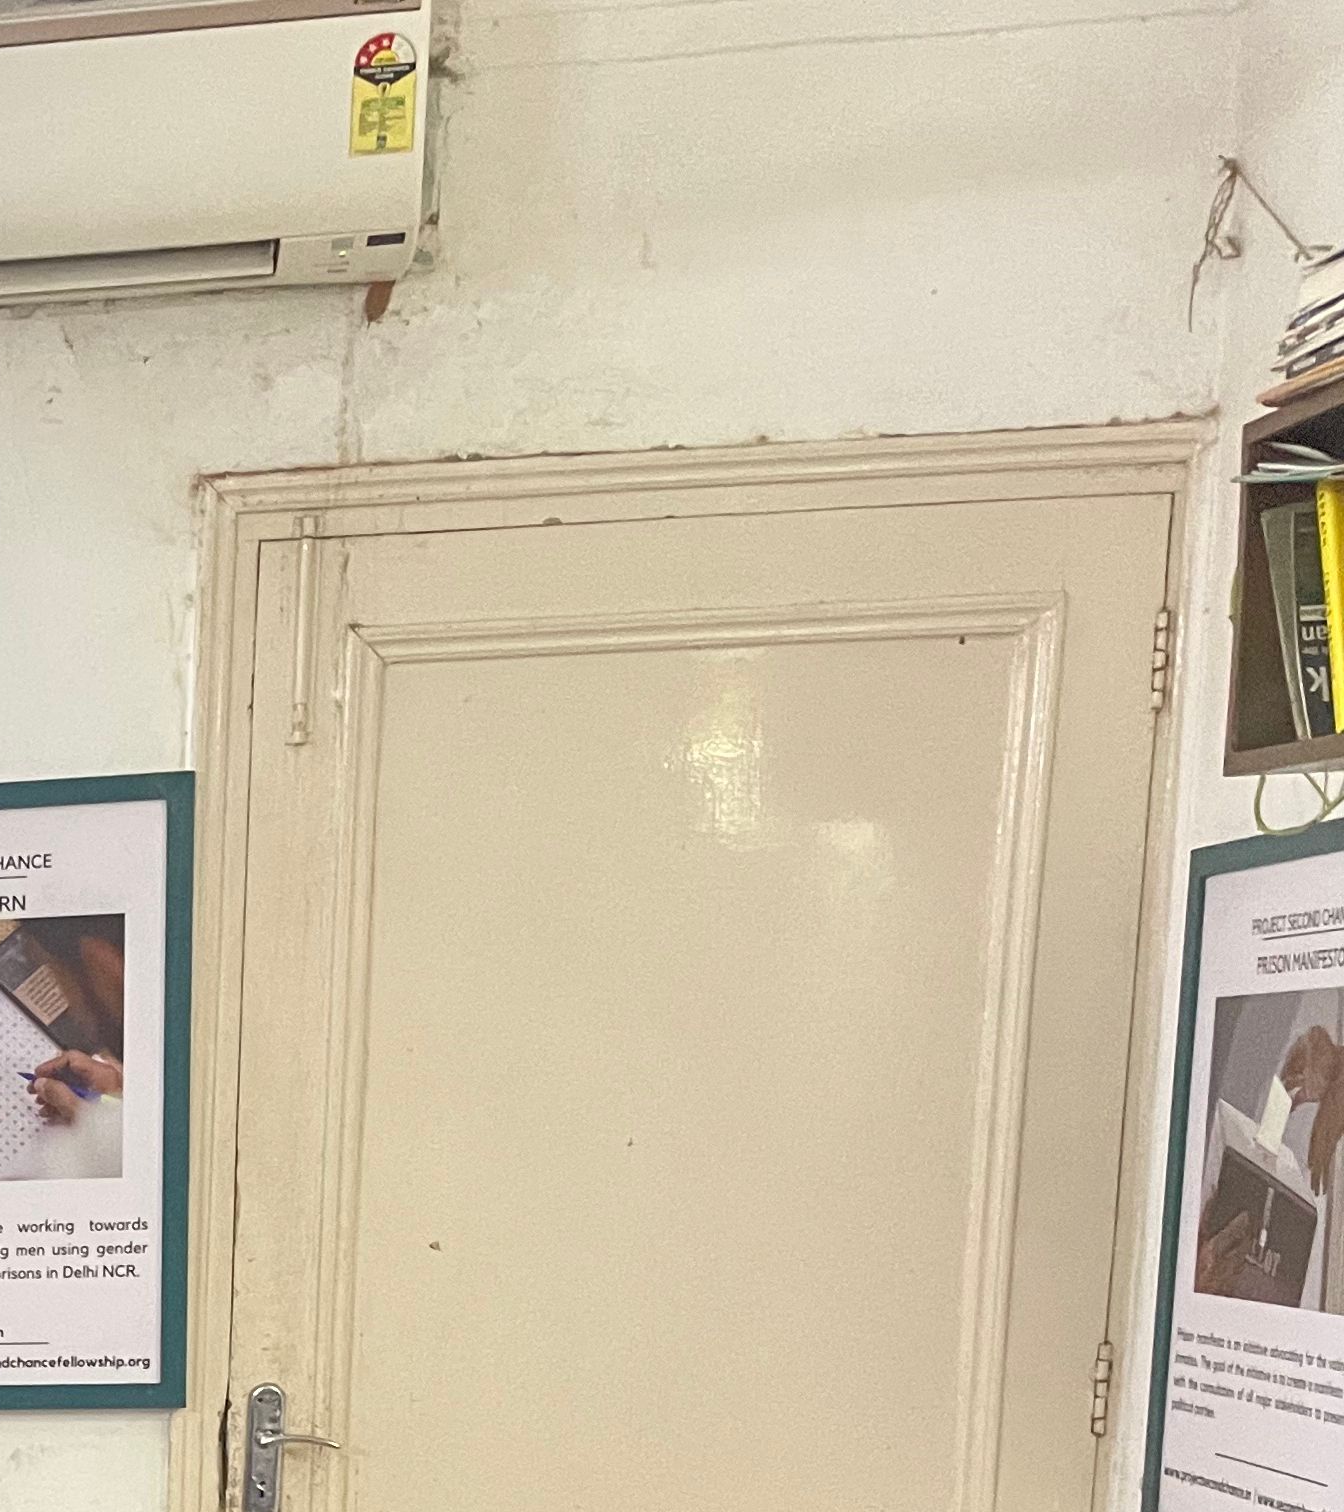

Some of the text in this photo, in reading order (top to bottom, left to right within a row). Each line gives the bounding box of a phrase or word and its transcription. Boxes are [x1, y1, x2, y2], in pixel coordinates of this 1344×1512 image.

[17, 1219, 75, 1235] working
[89, 1217, 148, 1231] towards
[15, 1245, 45, 1256] men
[52, 1244, 89, 1258] using
[96, 1241, 148, 1257] gender
[46, 1266, 58, 1279] in
[63, 1265, 98, 1279] Delhi
[102, 1264, 140, 1278] NCR.
